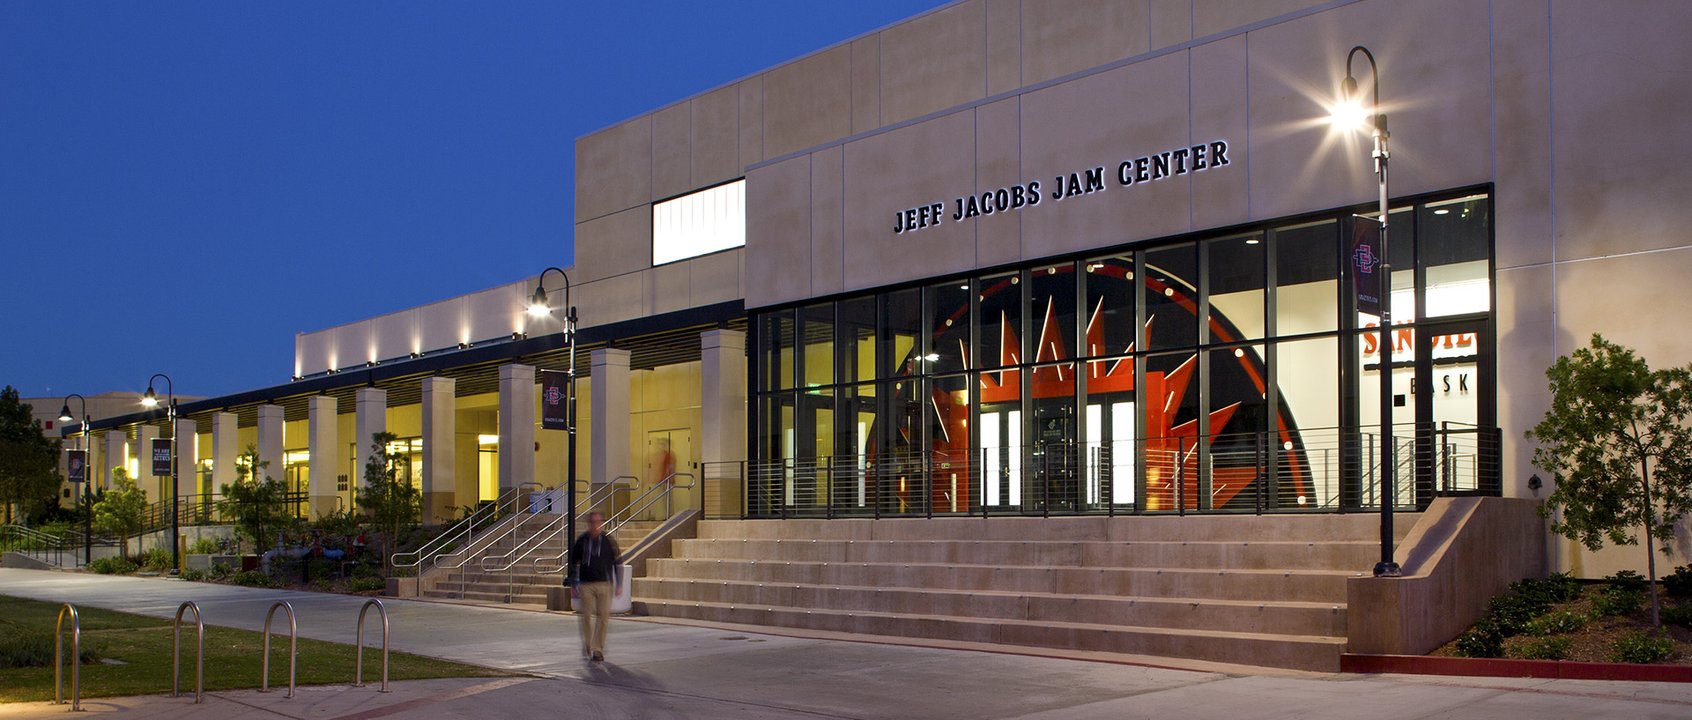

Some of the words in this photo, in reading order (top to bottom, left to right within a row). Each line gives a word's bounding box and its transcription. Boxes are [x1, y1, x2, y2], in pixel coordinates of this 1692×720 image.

[894, 203, 943, 233] JEFF
[953, 181, 1040, 221] JACOBS
[1052, 167, 1105, 200] JAM
[1118, 140, 1229, 186] CENTER
[1363, 319, 1416, 354] SN
